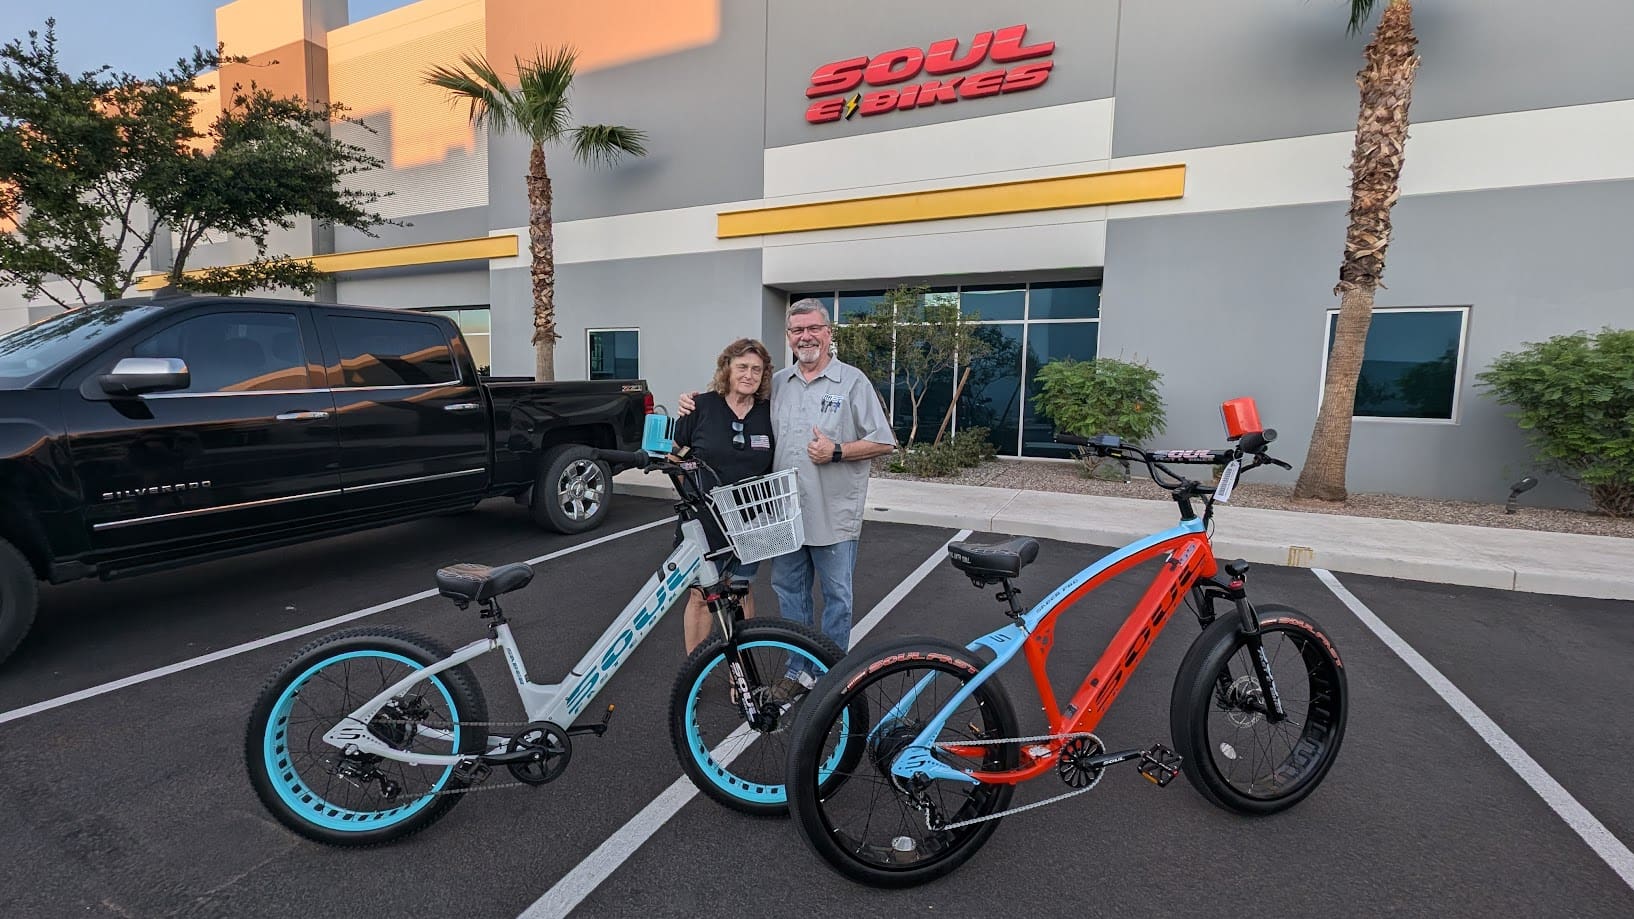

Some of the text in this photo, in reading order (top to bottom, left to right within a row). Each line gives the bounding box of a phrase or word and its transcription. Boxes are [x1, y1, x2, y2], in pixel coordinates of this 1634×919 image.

[806, 24, 1055, 98] SOUL
[102, 480, 211, 500] SILVERADO
[565, 556, 701, 716] SOUL
[868, 651, 926, 674] SOUL
[1095, 553, 1206, 714] SOUL
[729, 662, 757, 723] SOUL
